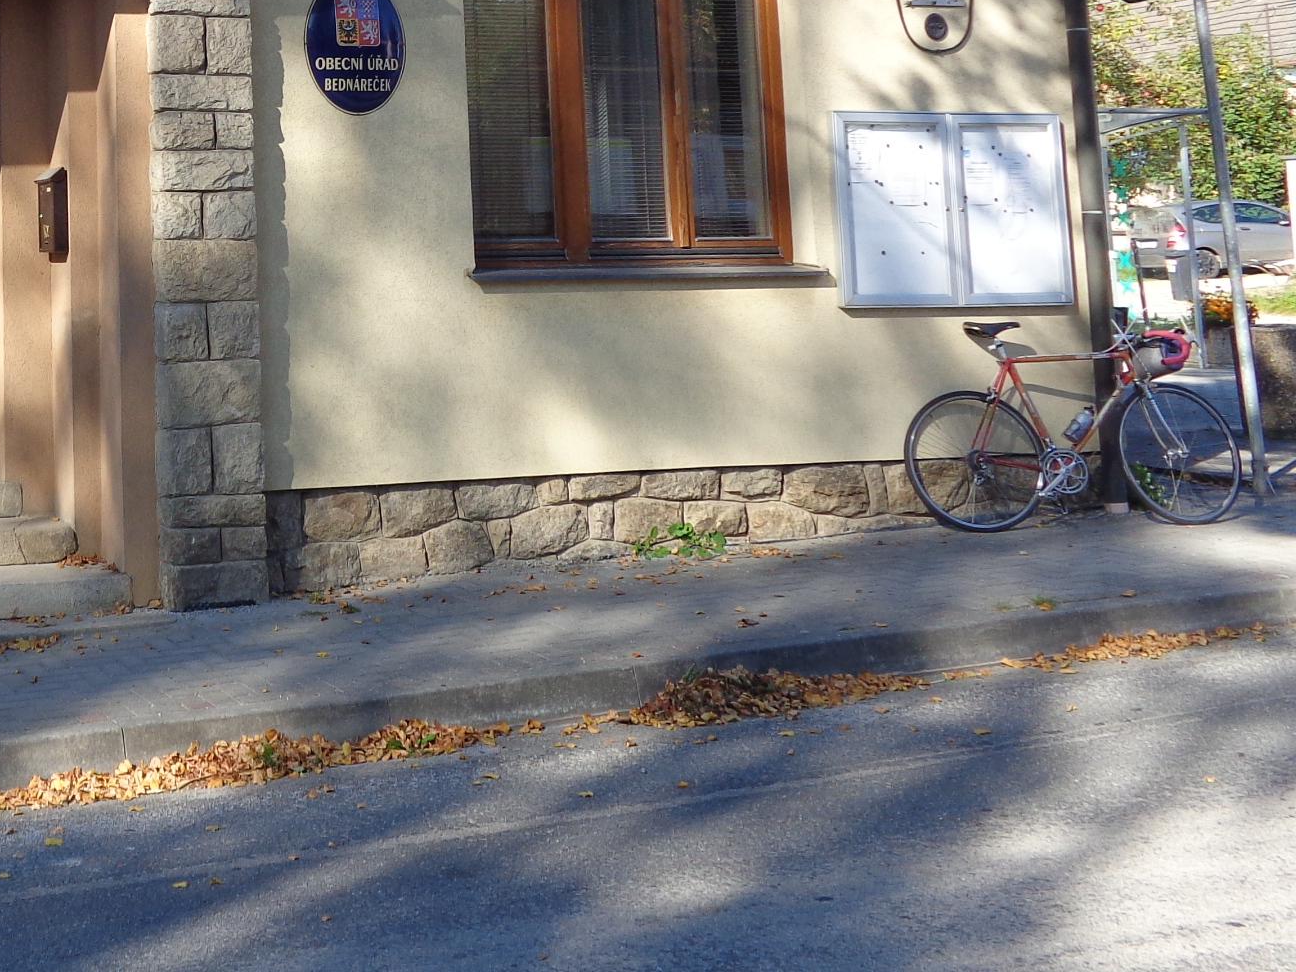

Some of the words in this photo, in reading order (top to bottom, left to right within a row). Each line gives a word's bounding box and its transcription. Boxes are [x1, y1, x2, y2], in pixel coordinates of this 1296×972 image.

[315, 55, 364, 71] OBECNÍ
[368, 55, 399, 71] ÚŘAD
[325, 75, 391, 92] BEDNÁREČEK
